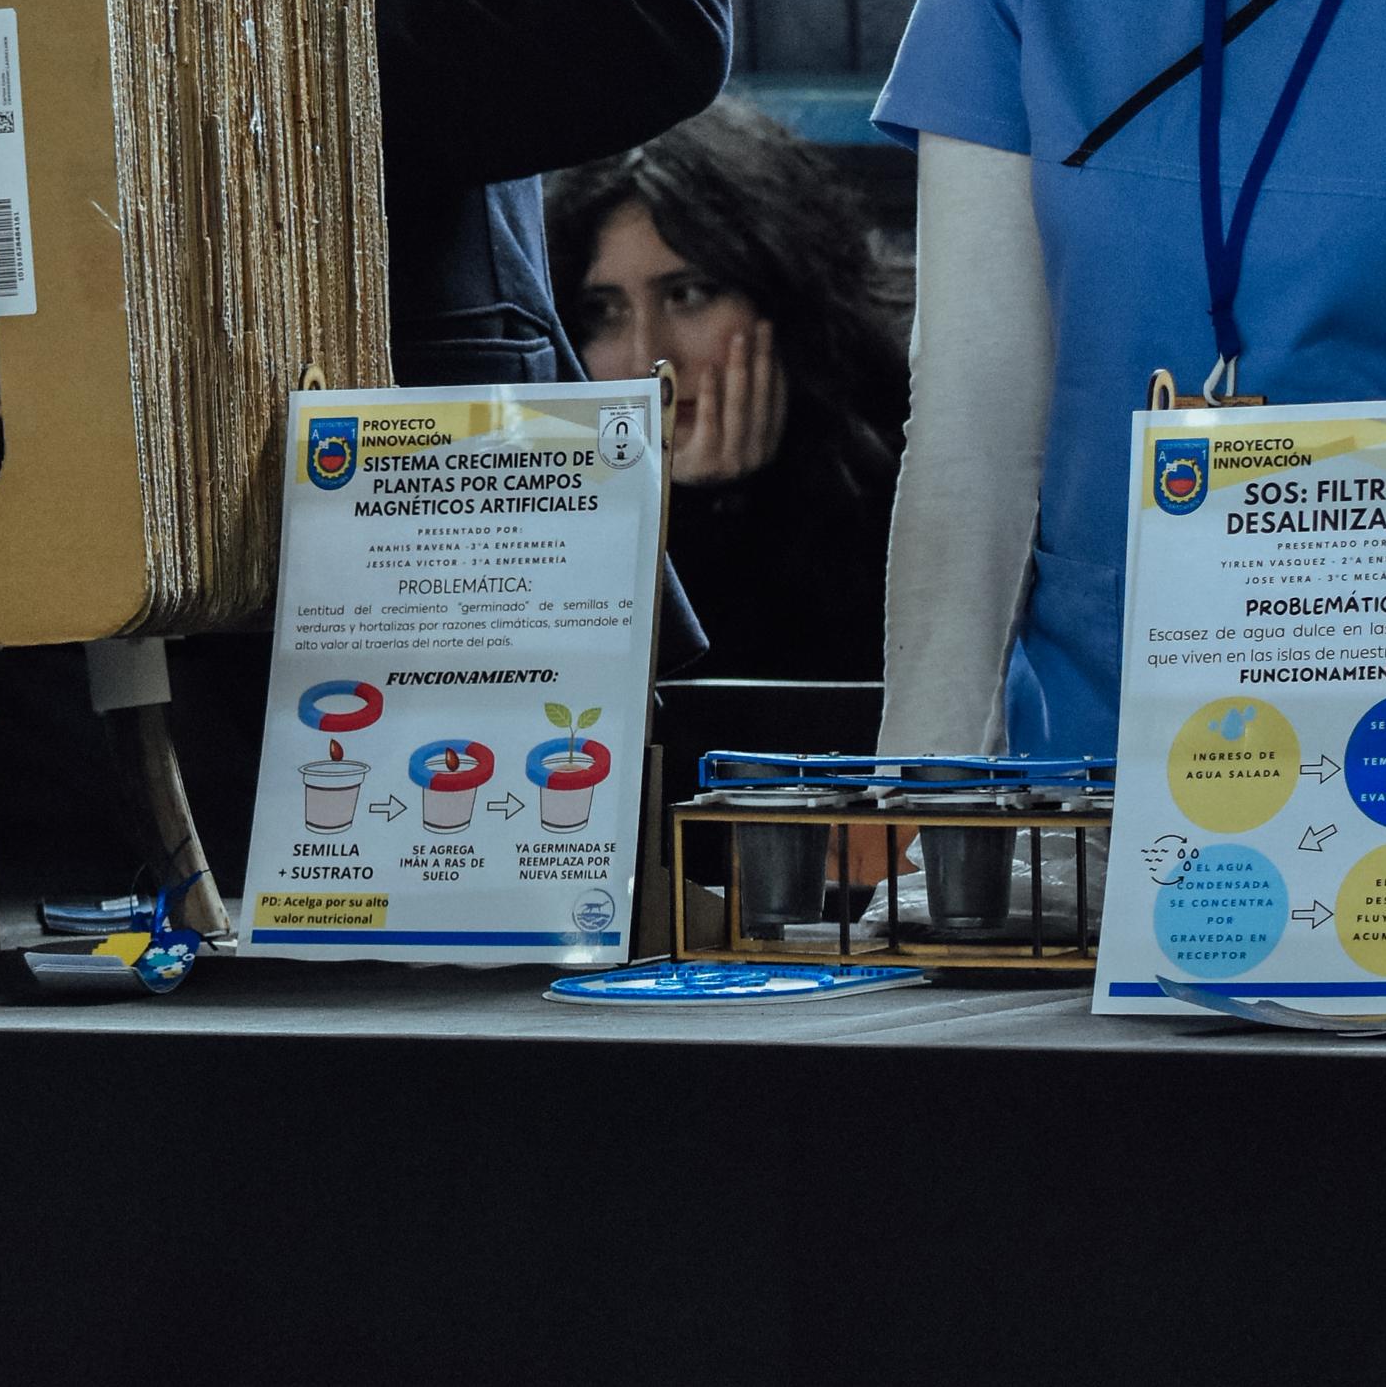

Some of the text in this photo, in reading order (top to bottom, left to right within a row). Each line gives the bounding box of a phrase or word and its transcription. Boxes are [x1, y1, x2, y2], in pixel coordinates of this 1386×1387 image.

[362, 418, 436, 431] PROYECTO
[361, 431, 452, 448] INNOVACIÓN
[1213, 438, 1295, 453] PROYECTO
[363, 454, 440, 473] SISTEMA
[444, 451, 568, 471] CRECIMIENTO
[572, 450, 595, 467] DE
[1213, 452, 1312, 470] INNOVACIÓN
[373, 472, 582, 495] PLANTAS POR CAMPOS
[1243, 481, 1308, 506] SOS:
[354, 494, 599, 517] MAGNÉTICOS ARTIFICIALES
[417, 526, 491, 536] PRESENTADO
[1277, 539, 1358, 550] PRESENTADO
[398, 575, 532, 595] PROBLEMÁTICA:
[297, 604, 345, 617] Lentitud
[353, 604, 372, 616] del
[380, 602, 449, 615] crecimiento
[538, 600, 554, 612] de
[562, 598, 609, 611] semillas
[618, 598, 634, 609] de
[1148, 627, 1209, 642] Escasez
[1215, 626, 1236, 640] de
[1243, 627, 1285, 643] agua
[1292, 623, 1336, 638] dulce
[1342, 624, 1362, 636] en
[385, 668, 559, 686] FUNCIONAMIENTO:
[1370, 721, 1386, 730] SE
[1193, 751, 1276, 762] INGRESO DE
[1186, 769, 1281, 780] AGUA SALADA
[292, 843, 360, 857] SEMILLA
[412, 844, 475, 856] SE AGREGA
[515, 842, 617, 854] YA GERMINADA SE
[399, 855, 485, 869] IMÁN A RAS DE
[518, 856, 611, 867] REEMPLAZA POR
[1196, 863, 1253, 873] EL AGUA
[290, 866, 374, 880] SUSTRATO
[422, 870, 460, 882] SUELO
[519, 869, 608, 881] NUEVA SEMILLA
[1176, 880, 1270, 891] CONDENSADA
[261, 895, 389, 910] PD: Acelga por su alto
[1169, 898, 1274, 908] SE CONCENTRA
[273, 912, 373, 925] valor nutricional
[1206, 916, 1234, 925] POR
[1170, 933, 1267, 943] GRAVEDAD EN
[1177, 951, 1247, 961] RECEPTOR
